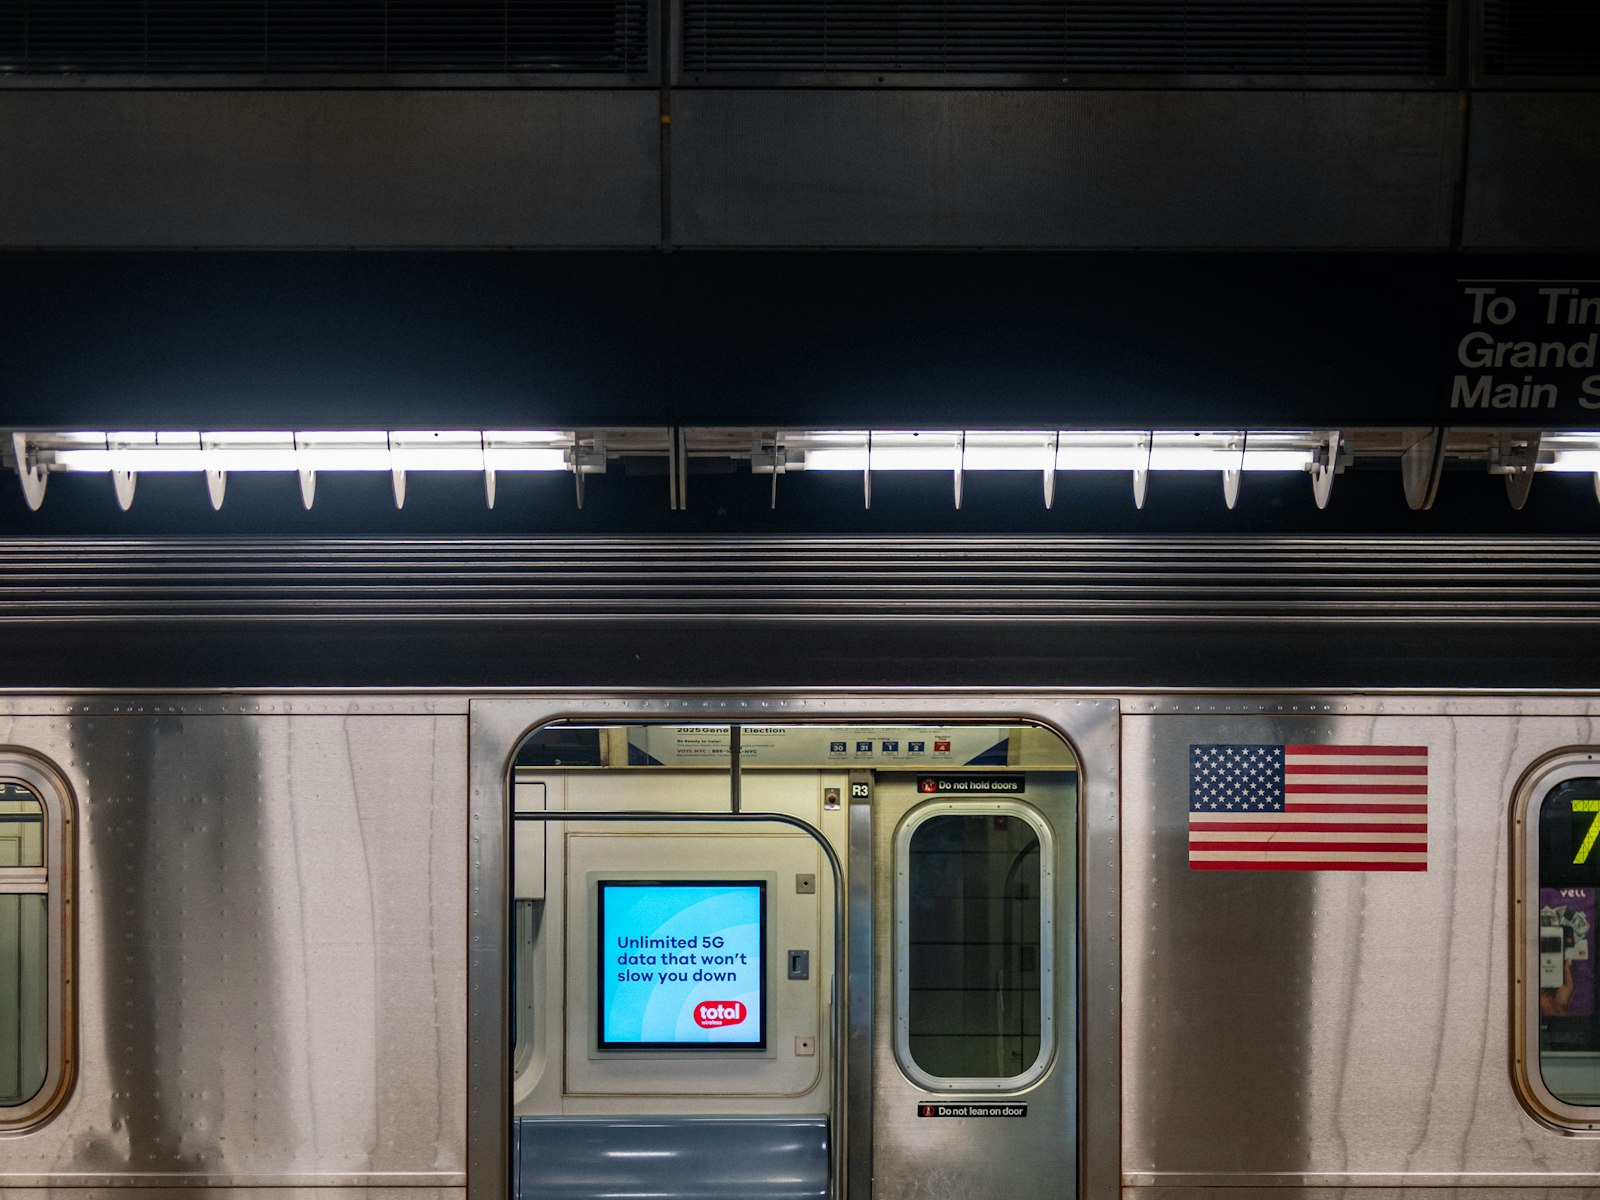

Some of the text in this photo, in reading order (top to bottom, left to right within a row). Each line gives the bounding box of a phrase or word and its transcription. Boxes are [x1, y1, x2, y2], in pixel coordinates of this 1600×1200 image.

[1464, 287, 1517, 325] To
[1457, 331, 1598, 369] Grand
[1450, 375, 1558, 409] Main
[852, 785, 868, 796] R3
[939, 781, 1018, 790] Do not hold doors
[1572, 800, 1600, 864] 7
[618, 936, 724, 948] Unlimited 5G
[618, 952, 656, 965] data
[661, 952, 697, 965] that
[618, 969, 736, 984] slow you down
[700, 1003, 740, 1020] total
[938, 1107, 952, 1115] Do
[953, 1107, 968, 1115] not
[970, 1107, 988, 1115] lean
[1002, 1107, 1023, 1115] door
